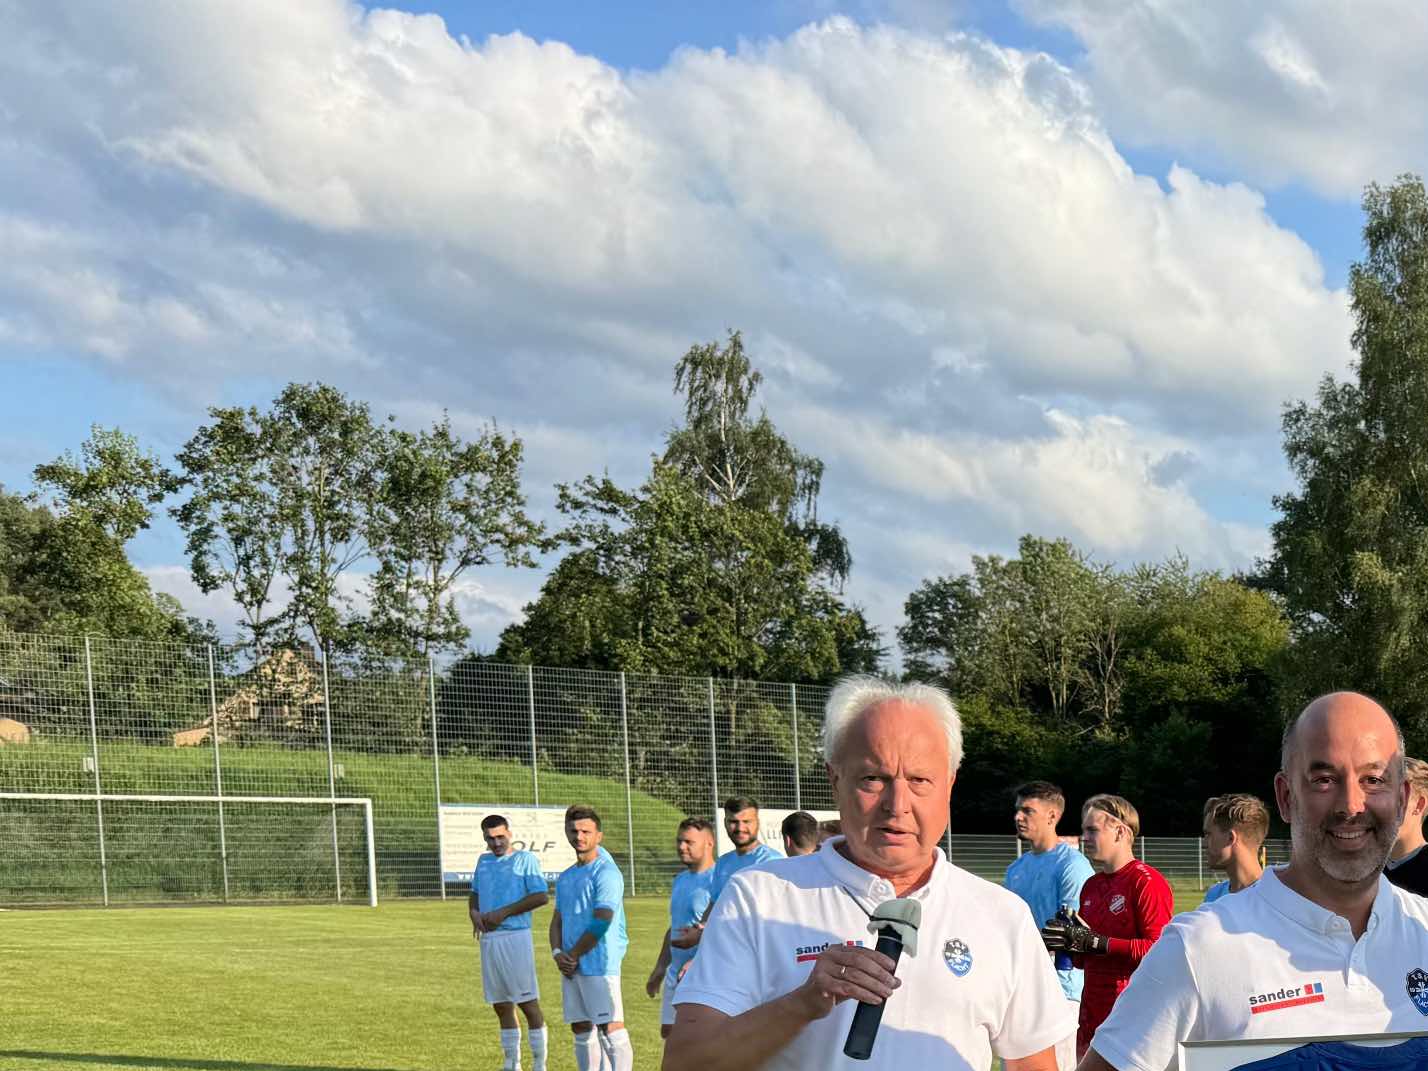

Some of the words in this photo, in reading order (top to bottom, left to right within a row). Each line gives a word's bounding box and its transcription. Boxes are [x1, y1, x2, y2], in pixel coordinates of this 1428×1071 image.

[512, 841, 556, 852] OLF
[795, 943, 829, 955] sand
[1250, 986, 1301, 1006] sander
